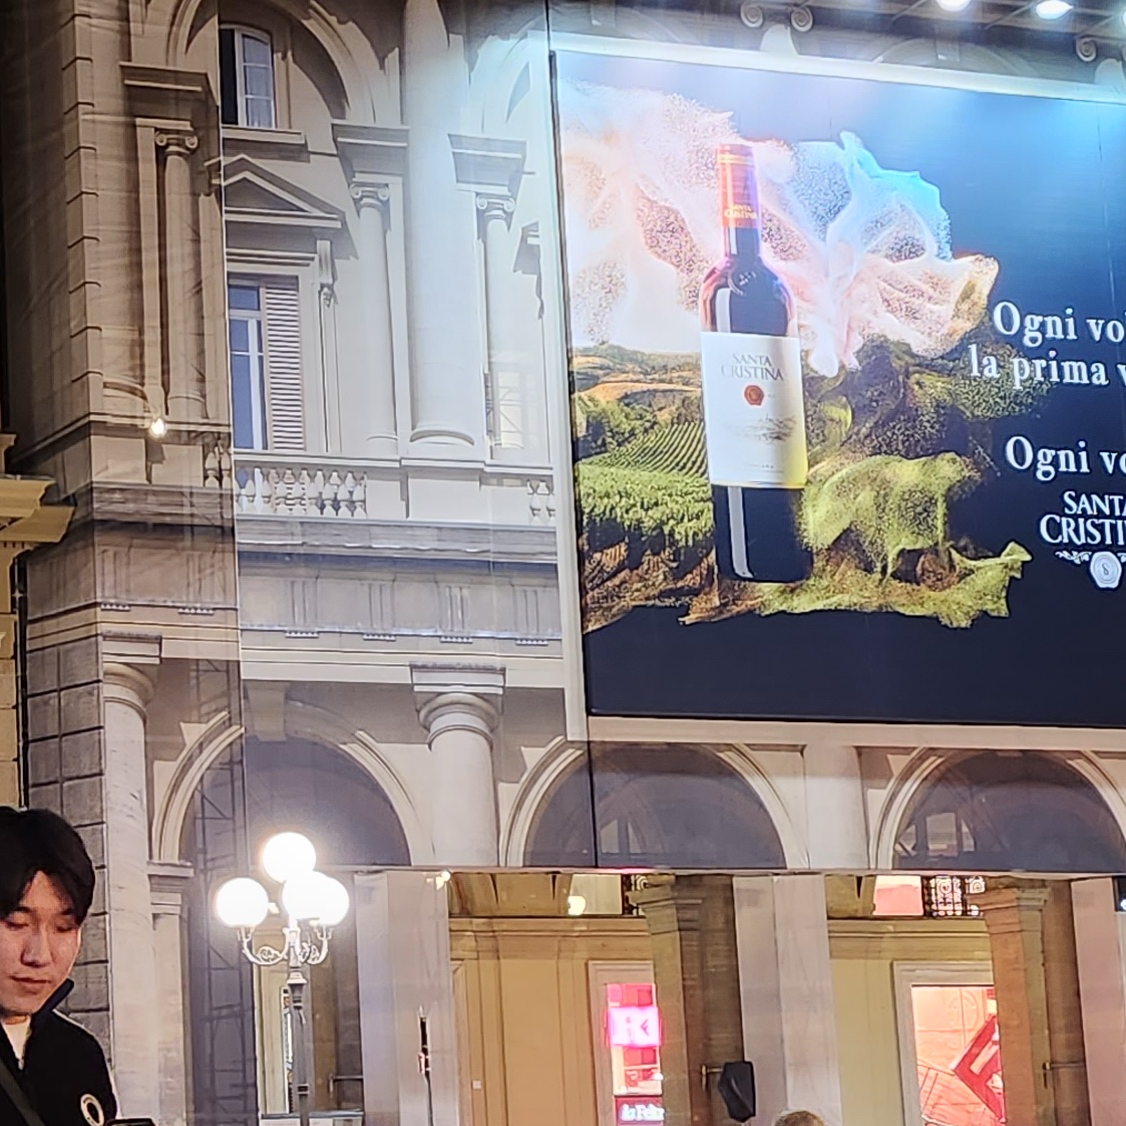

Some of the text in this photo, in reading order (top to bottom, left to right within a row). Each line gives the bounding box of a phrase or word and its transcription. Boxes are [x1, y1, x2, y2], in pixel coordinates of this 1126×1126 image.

[993, 301, 1126, 348] Ogni vo
[721, 364, 784, 382] CRISTINA
[732, 353, 773, 367] SANTA
[968, 343, 1002, 379] la
[1010, 350, 1110, 390] prima
[1005, 435, 1090, 482] Ogni
[1063, 491, 1126, 516] SANT
[1040, 514, 1126, 545] CRISTI
